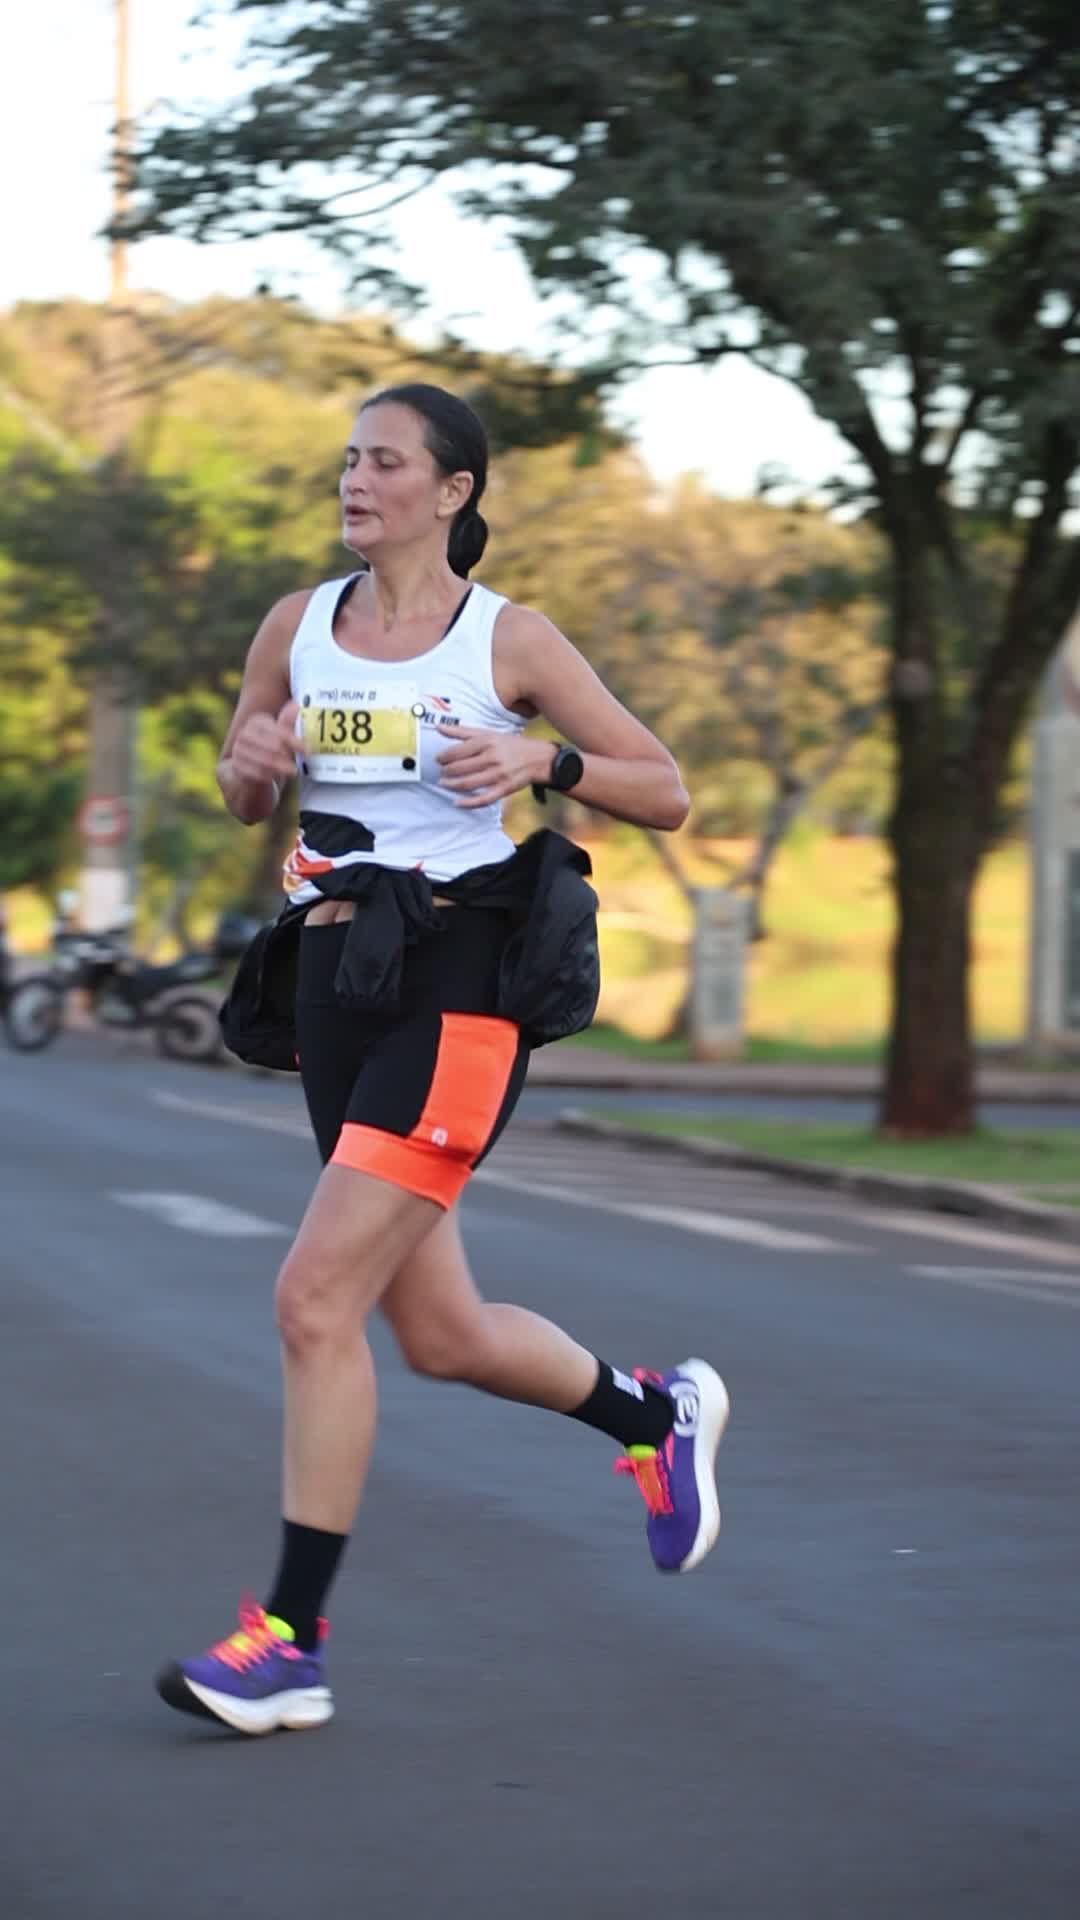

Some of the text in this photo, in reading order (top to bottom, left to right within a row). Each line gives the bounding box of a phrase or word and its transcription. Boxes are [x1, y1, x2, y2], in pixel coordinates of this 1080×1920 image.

[340, 690, 365, 702] RUN
[439, 714, 461, 726] RUN
[317, 709, 373, 744] 138
